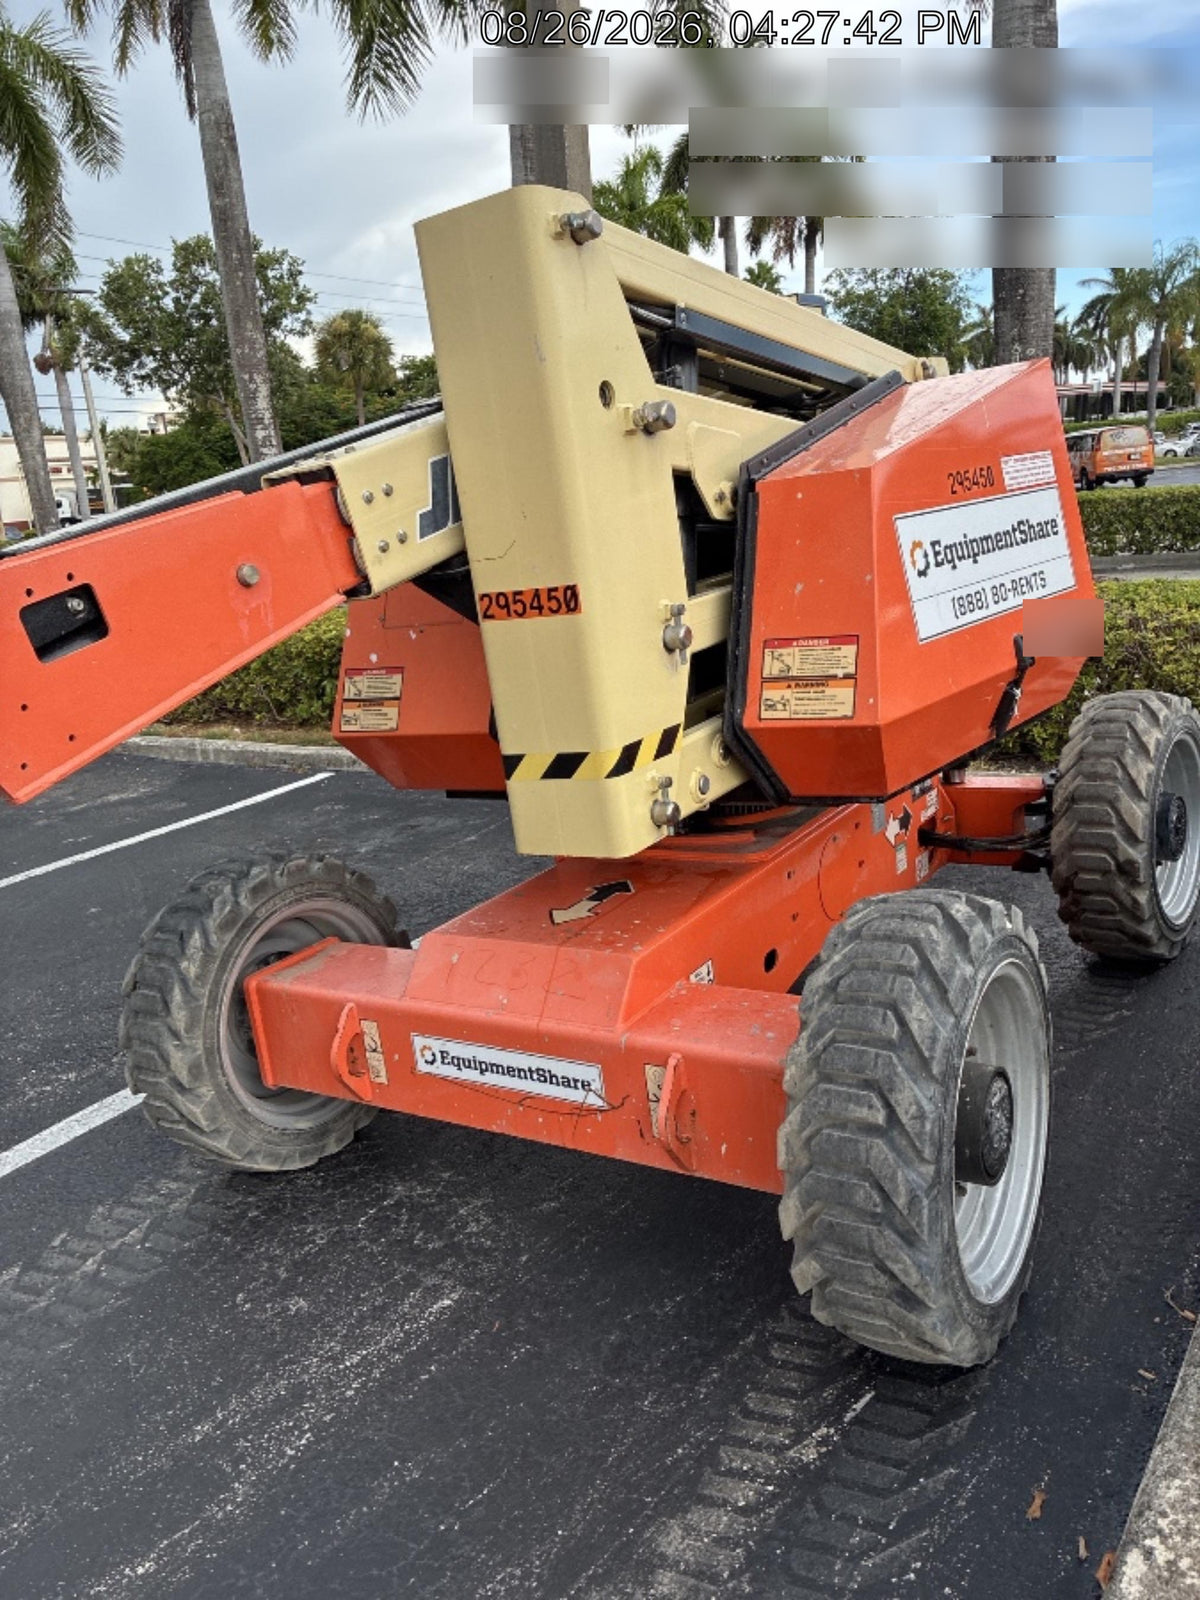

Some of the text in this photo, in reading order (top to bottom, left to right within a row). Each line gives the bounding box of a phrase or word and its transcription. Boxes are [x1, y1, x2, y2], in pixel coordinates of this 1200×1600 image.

[947, 466, 995, 494] 295450
[929, 518, 1059, 570] EquipmentShare
[479, 584, 579, 619] 295450
[952, 570, 1047, 619] (888) 80-RENTS
[438, 1049, 592, 1091] EquipmentShare
